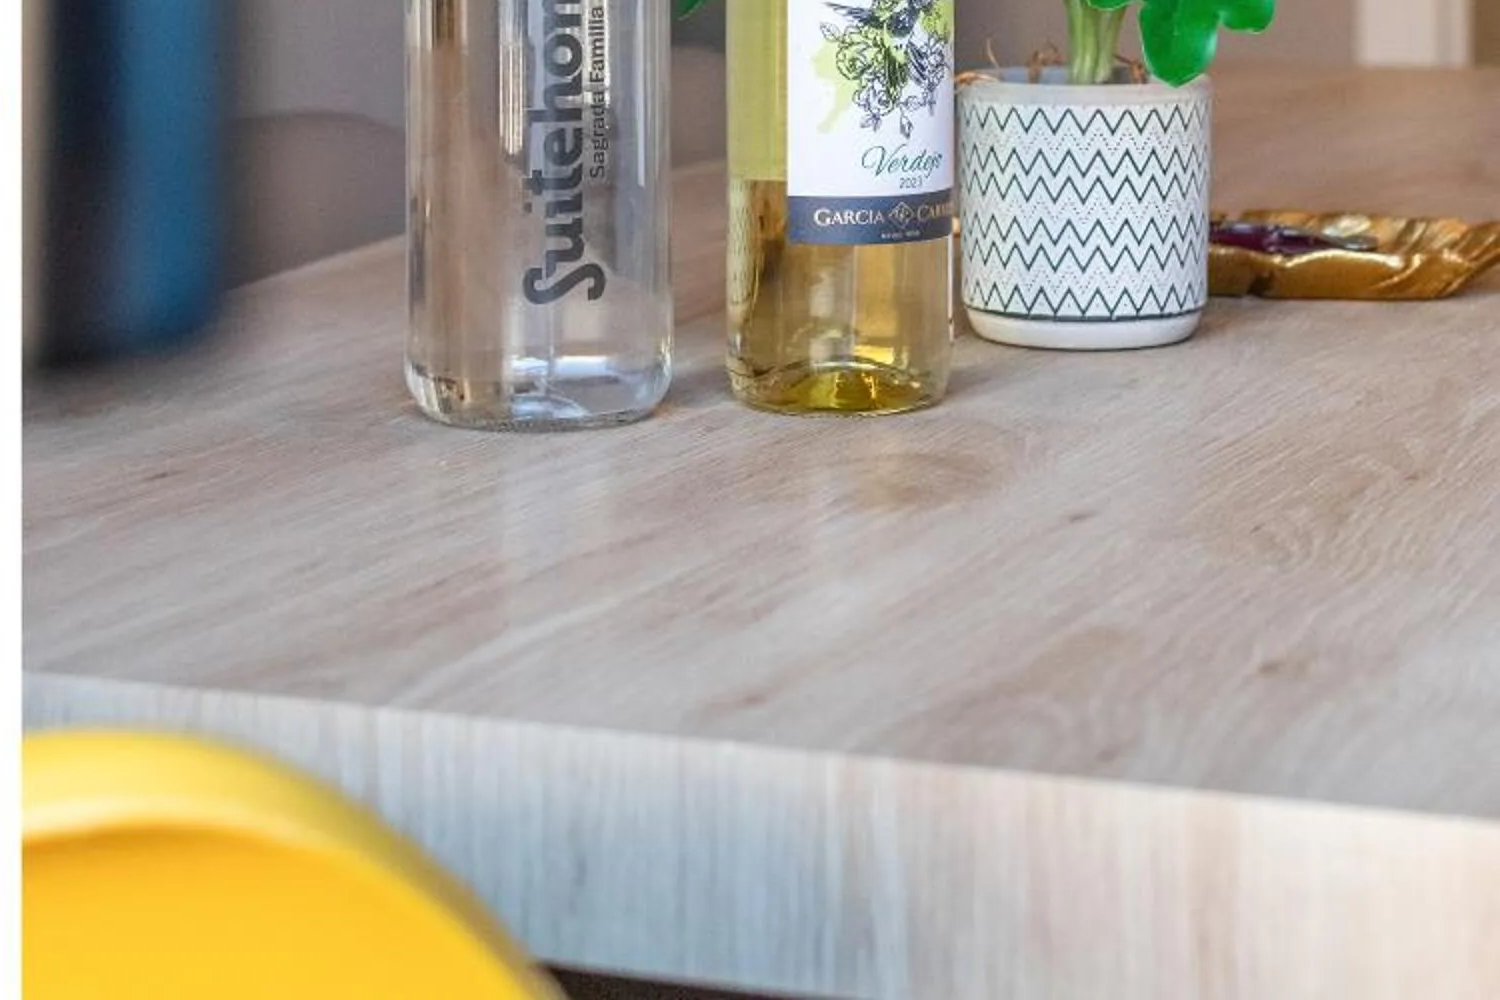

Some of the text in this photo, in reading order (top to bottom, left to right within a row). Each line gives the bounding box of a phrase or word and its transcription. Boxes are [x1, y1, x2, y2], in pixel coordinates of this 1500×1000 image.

[588, 6, 609, 178] Sagrada Familia
[861, 143, 943, 179] Verdejo
